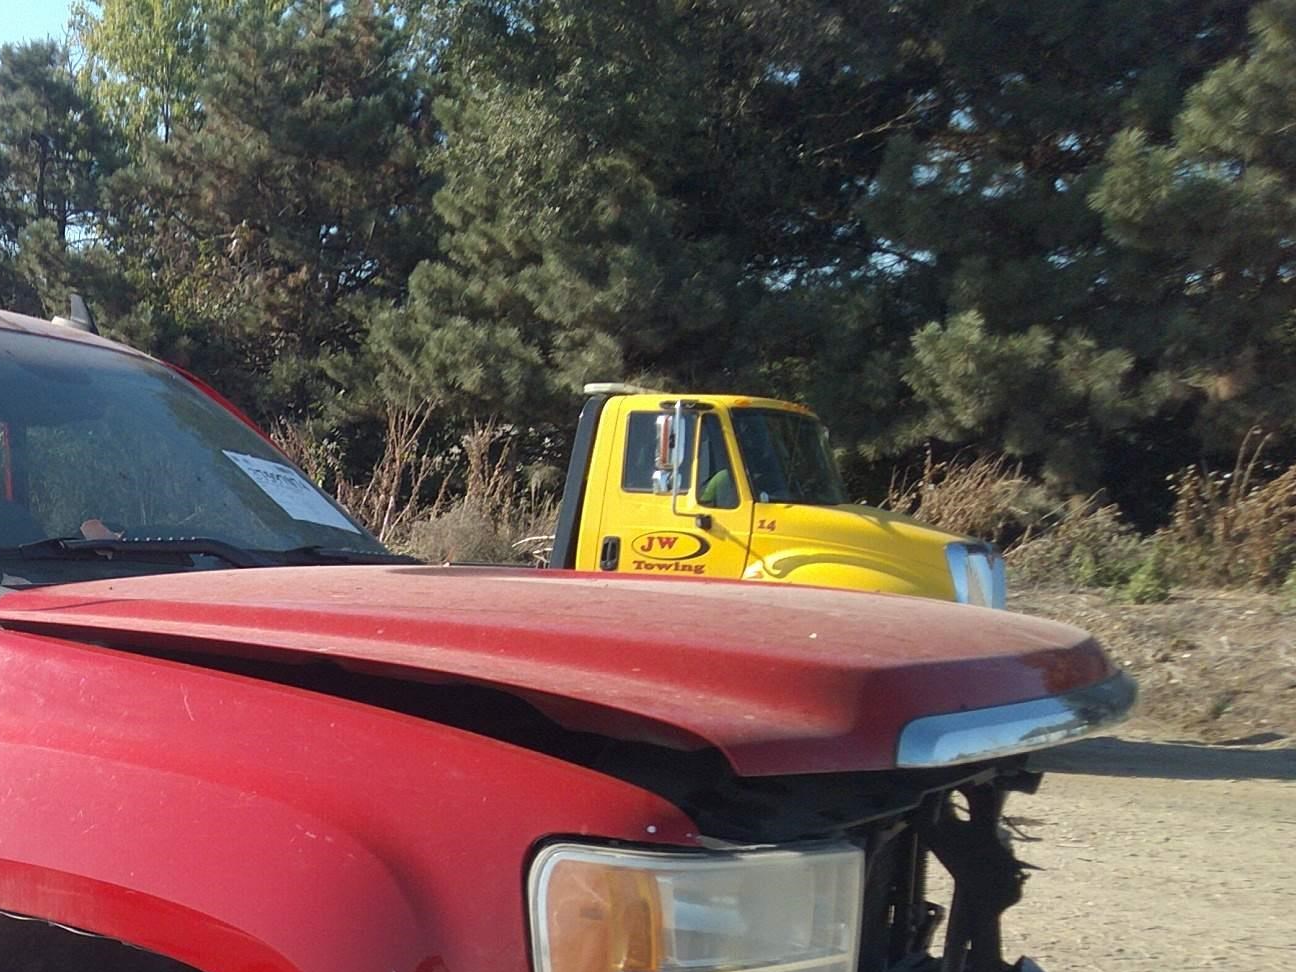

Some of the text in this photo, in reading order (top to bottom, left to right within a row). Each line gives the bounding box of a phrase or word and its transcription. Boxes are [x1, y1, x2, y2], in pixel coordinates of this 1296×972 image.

[758, 520, 776, 531] 14
[640, 536, 678, 552] JW
[633, 560, 705, 574] Towing
